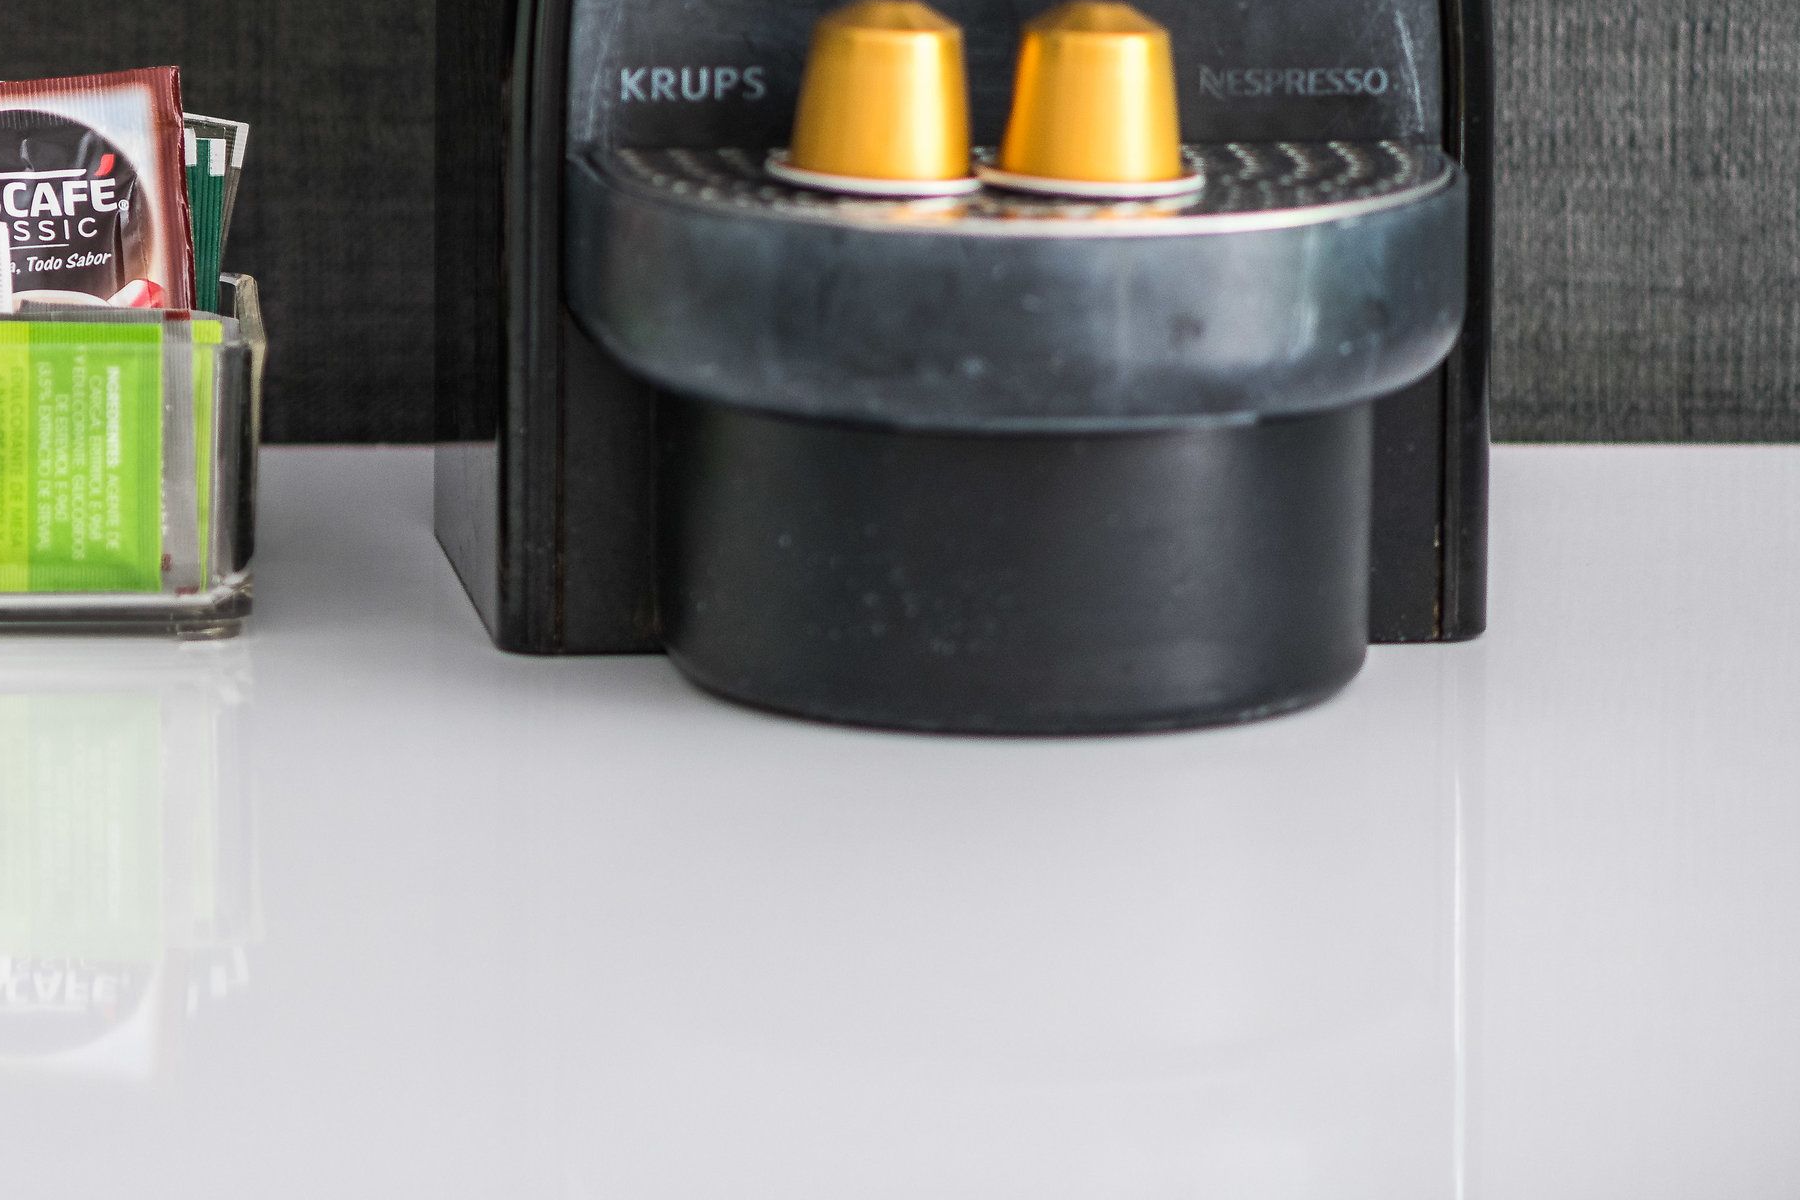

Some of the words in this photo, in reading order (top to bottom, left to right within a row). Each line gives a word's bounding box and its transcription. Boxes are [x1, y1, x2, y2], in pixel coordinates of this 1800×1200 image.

[620, 67, 766, 102] KRUPS
[1198, 64, 1390, 99] NESPRESSO
[13, 217, 98, 242] SSIC
[27, 255, 64, 273] Todo
[66, 250, 112, 270] Sabor
